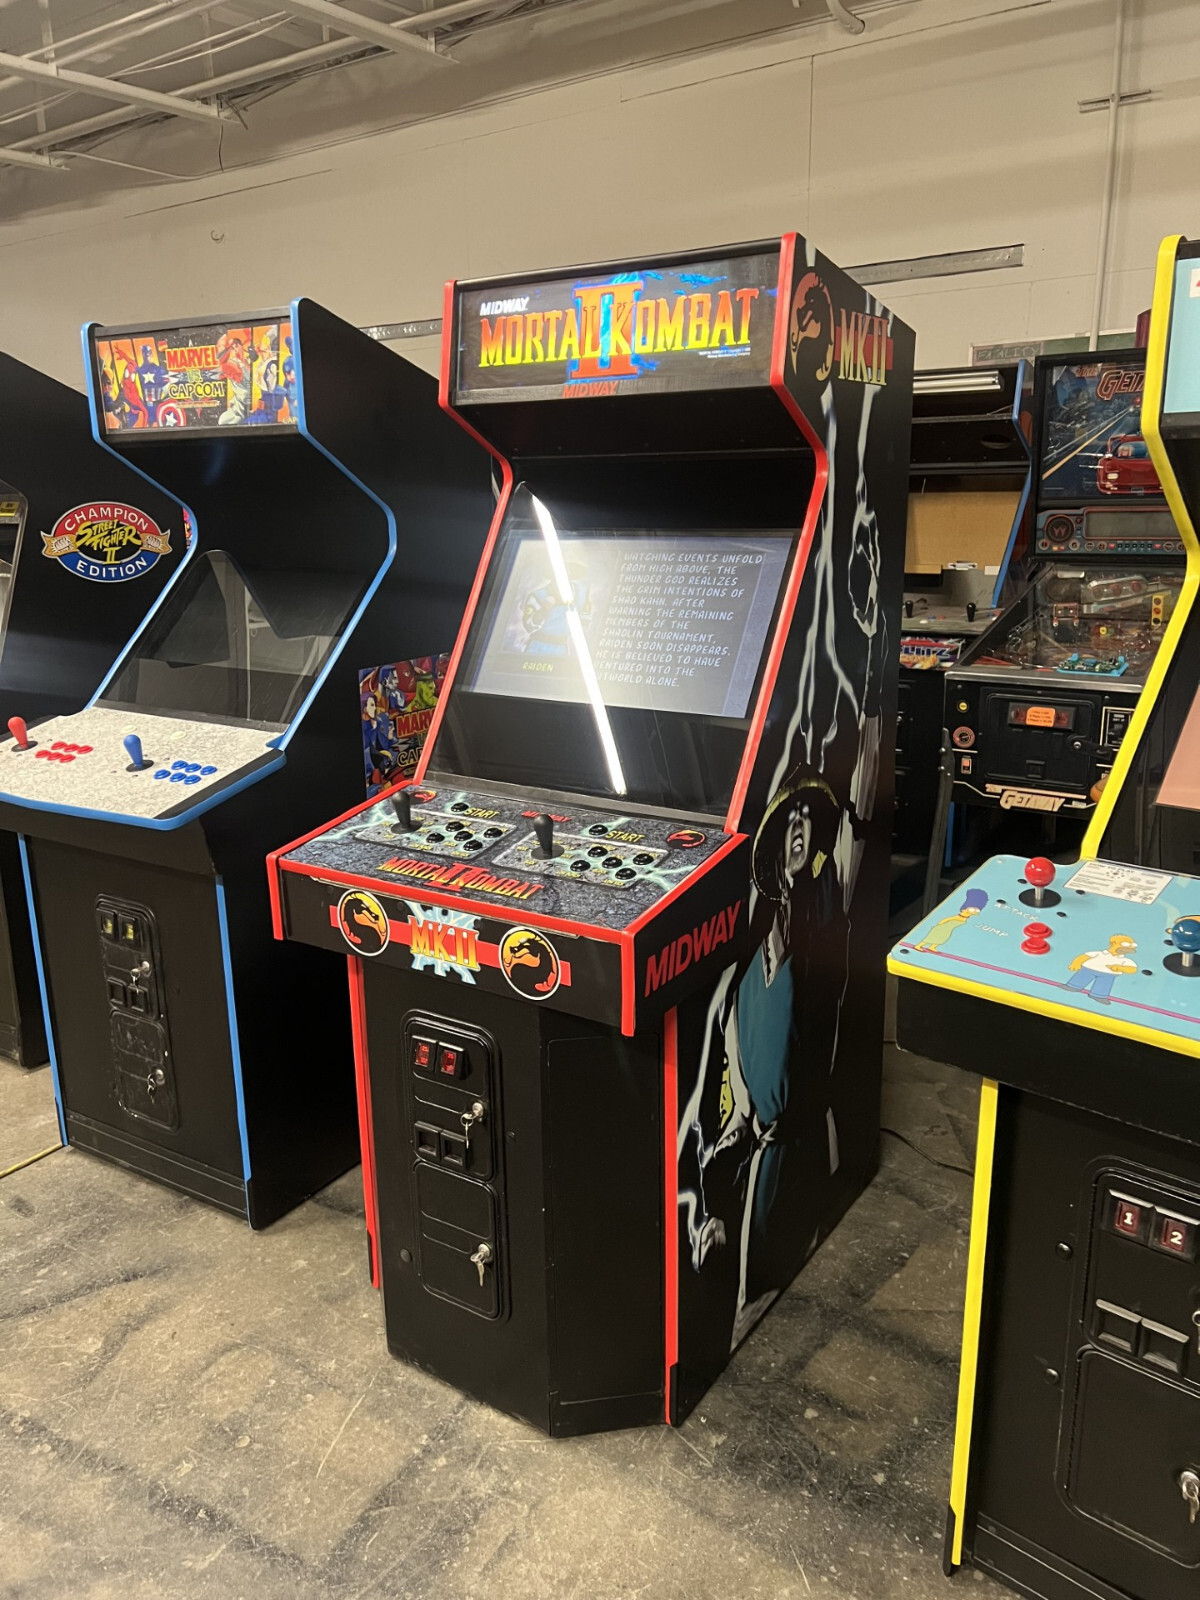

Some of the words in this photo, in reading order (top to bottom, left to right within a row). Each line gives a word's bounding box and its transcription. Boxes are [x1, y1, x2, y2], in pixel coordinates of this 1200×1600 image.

[480, 297, 530, 316] MIDWAY
[478, 308, 602, 368] MORTAL
[608, 288, 759, 356] KOMBAT
[838, 308, 888, 386] MKII
[165, 345, 220, 371] MARVEL
[169, 381, 224, 399] CAPCOM
[562, 381, 619, 398] MIDWAY
[64, 506, 149, 531] CHAMPION
[76, 519, 118, 546] STREET
[87, 526, 142, 551] FIGHTER
[102, 547, 121, 564] II
[624, 553, 675, 561] WATCHING
[678, 553, 718, 563] EVENTS
[722, 554, 763, 564] UNFOLD
[76, 557, 148, 578] EDITION
[620, 564, 646, 572] FROM
[649, 564, 672, 573] HIGH
[676, 565, 711, 575] ABOVE,
[717, 566, 737, 574] THE
[619, 574, 662, 583] THUNDER
[665, 575, 685, 584] GOD
[688, 576, 739, 586] REALIZES
[616, 585, 633, 593] THE
[637, 586, 660, 594] GRIM
[664, 587, 726, 597] INTENTIONS
[731, 588, 745, 598] OF
[611, 595, 637, 604] SHAO
[672, 598, 705, 608] AFTER
[608, 607, 652, 616] WARNING
[656, 608, 675, 618] THE
[678, 609, 734, 620] REMAINING
[605, 617, 649, 627] MEMBERS
[653, 619, 666, 628] OF
[671, 620, 691, 630] THE
[602, 628, 643, 638] SHAOLIN
[599, 639, 633, 649] RAIDEN
[636, 641, 663, 651] SOON
[666, 642, 731, 656] DISAPPEARS.
[522, 662, 554, 672] RAIDEN
[595, 650, 608, 658] HE
[611, 651, 622, 659] IS
[625, 652, 673, 663] BELIEVED
[677, 655, 692, 665] TO
[694, 656, 722, 667] HAVE
[594, 661, 643, 672] VENTURED
[645, 664, 671, 675] INTO
[675, 667, 695, 677] THE
[597, 672, 643, 684] UTWORLD
[645, 675, 680, 688] ALONE.
[465, 807, 500, 819] START
[605, 830, 645, 843] START
[376, 857, 451, 882] MORTAL
[449, 869, 545, 899] KOMBAT
[994, 902, 1039, 921] ATTACK
[974, 924, 1008, 937] JUMP
[408, 916, 480, 971] MKII
[644, 900, 742, 998] MIDWAY
[1124, 1212, 1133, 1225] 1
[1170, 1231, 1183, 1245] 2
